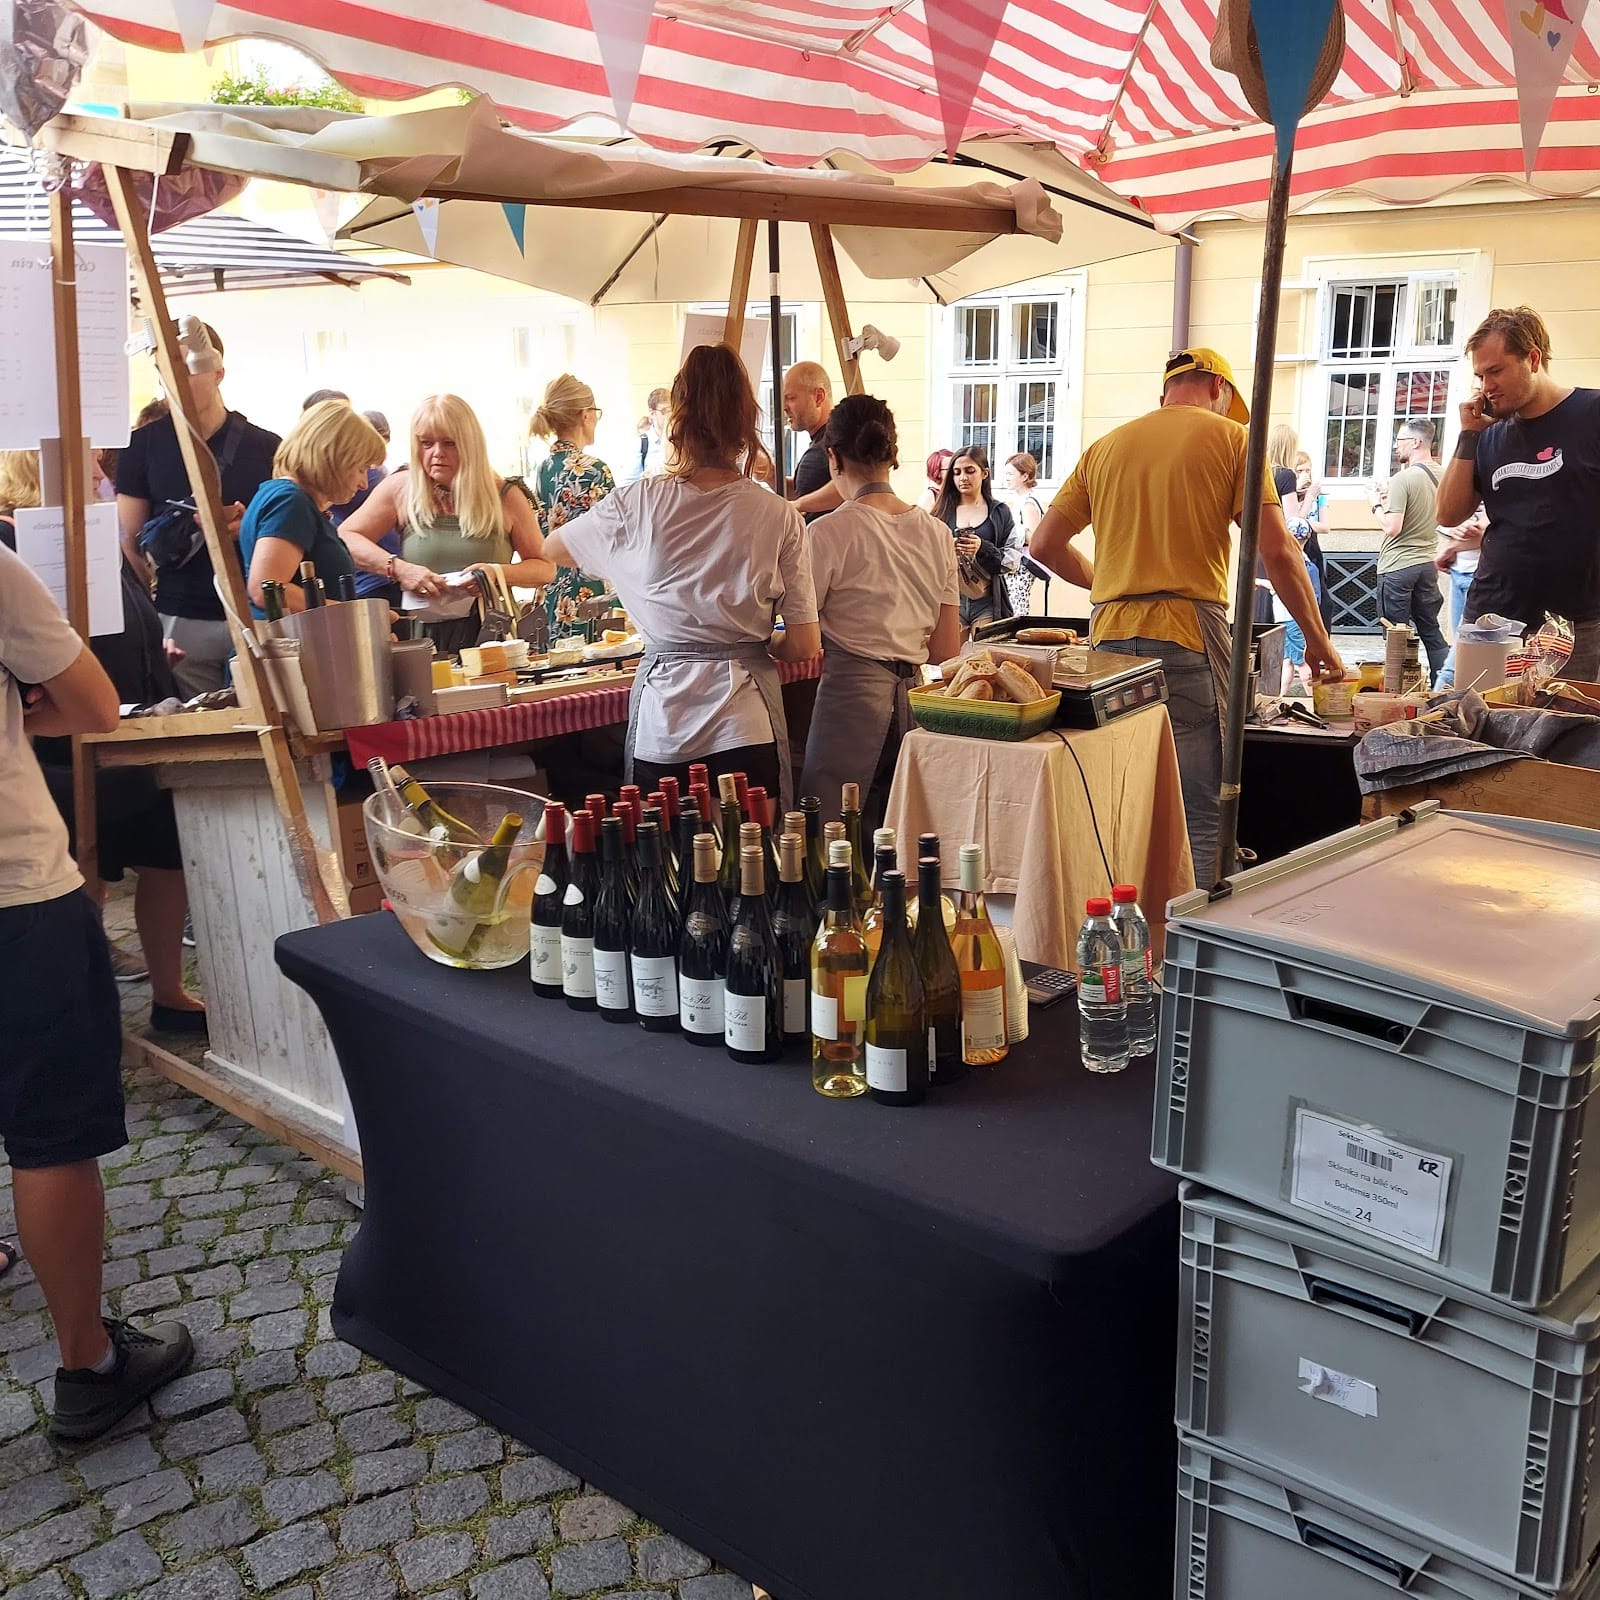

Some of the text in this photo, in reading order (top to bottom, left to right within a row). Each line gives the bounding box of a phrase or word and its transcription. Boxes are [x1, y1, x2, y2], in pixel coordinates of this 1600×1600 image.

[1327, 1159, 1359, 1178] Sklenka
[1360, 1171, 1372, 1182] na
[1389, 1181, 1409, 1196] víno
[1334, 1179, 1399, 1210] Bohemia 350ml
[1355, 1207, 1373, 1223] 24
